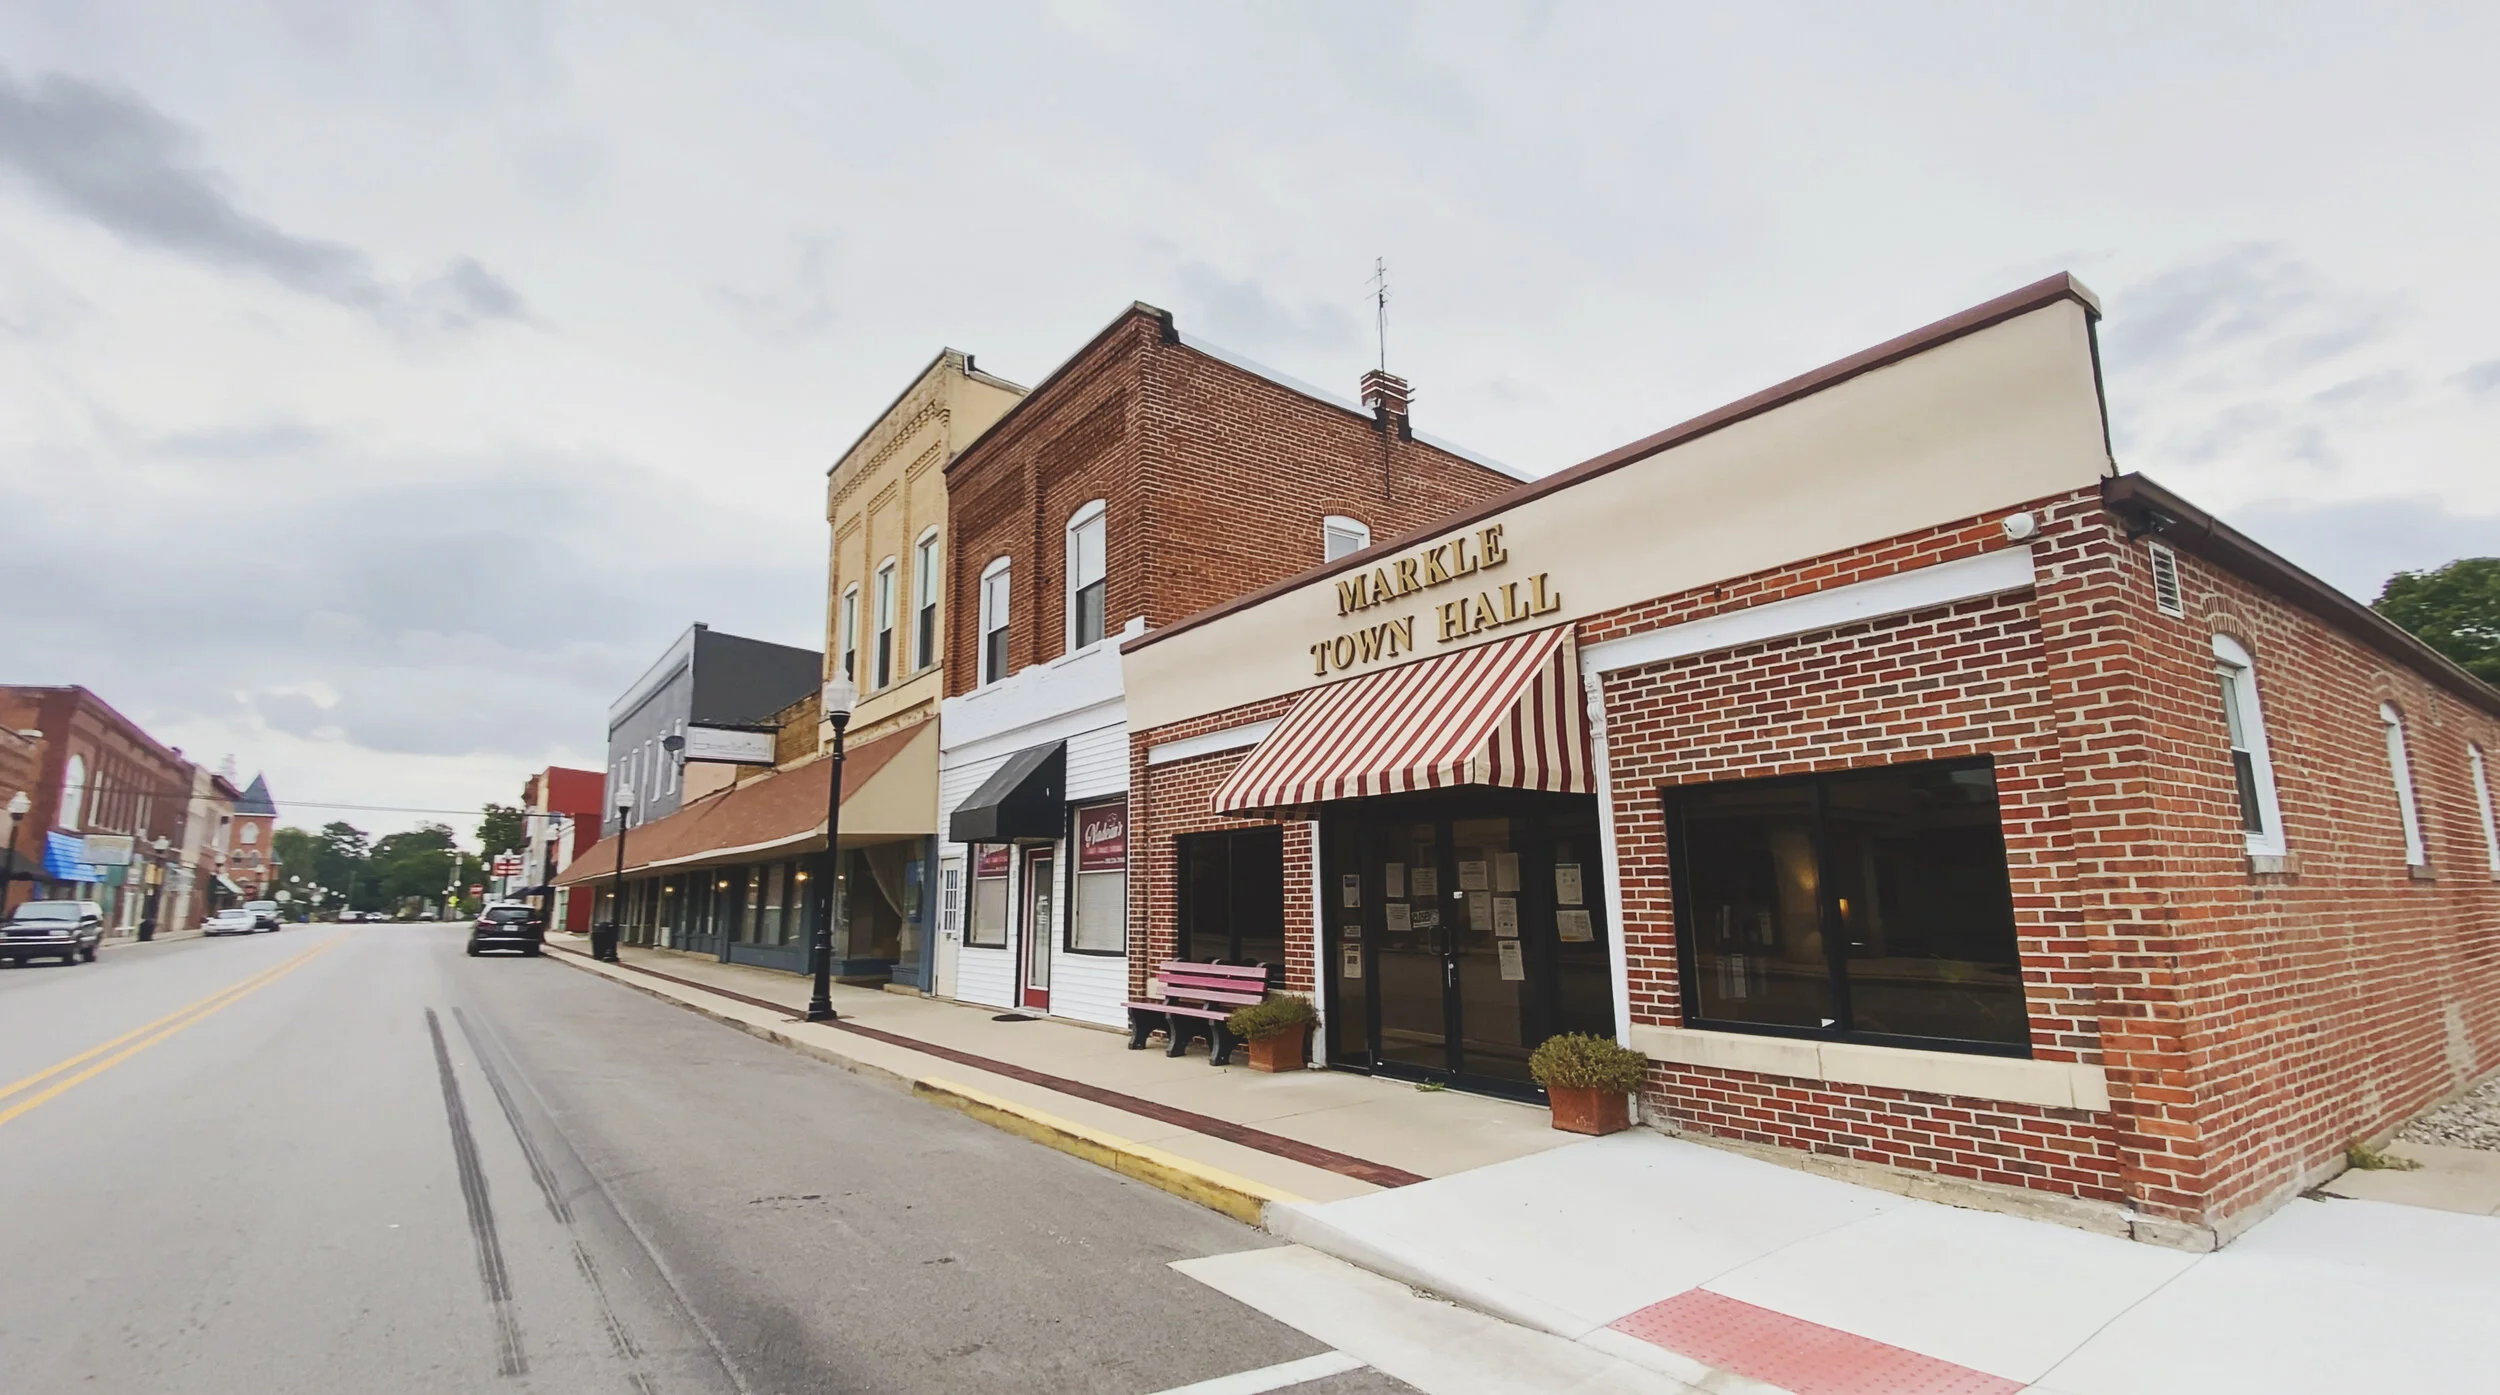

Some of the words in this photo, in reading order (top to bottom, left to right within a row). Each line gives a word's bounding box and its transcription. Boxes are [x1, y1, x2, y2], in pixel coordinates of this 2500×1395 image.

[1335, 523, 1507, 616] MARKLE
[1310, 615, 1415, 676] TOWN
[1435, 573, 1561, 643] HALL
